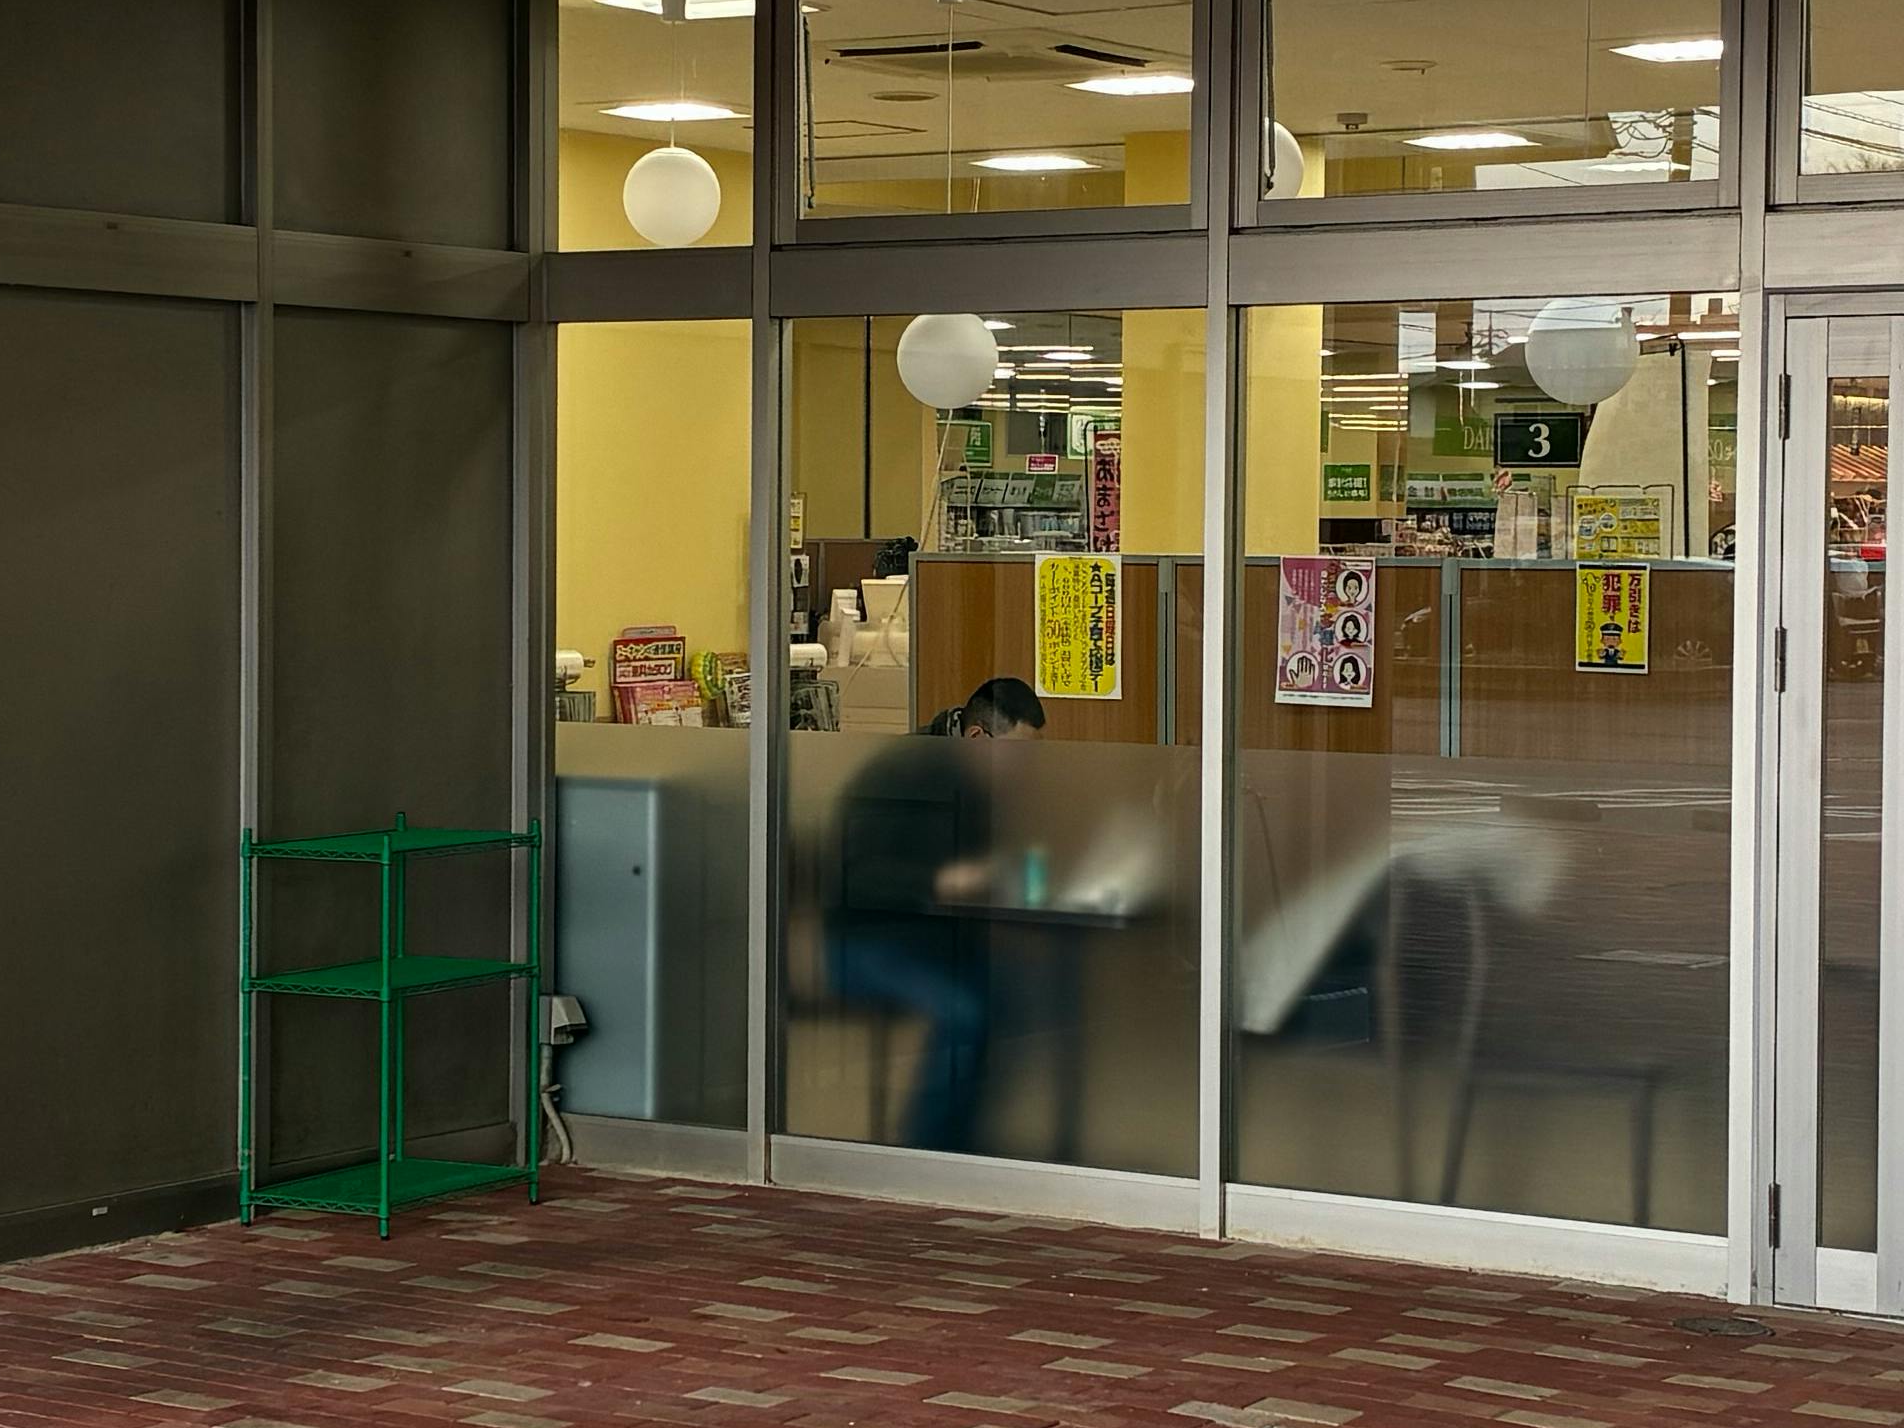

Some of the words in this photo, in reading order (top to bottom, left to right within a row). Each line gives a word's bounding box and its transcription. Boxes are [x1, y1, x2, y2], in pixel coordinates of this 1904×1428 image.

[1528, 423, 1551, 458] 3
[1628, 573, 1642, 634] 万引きは
